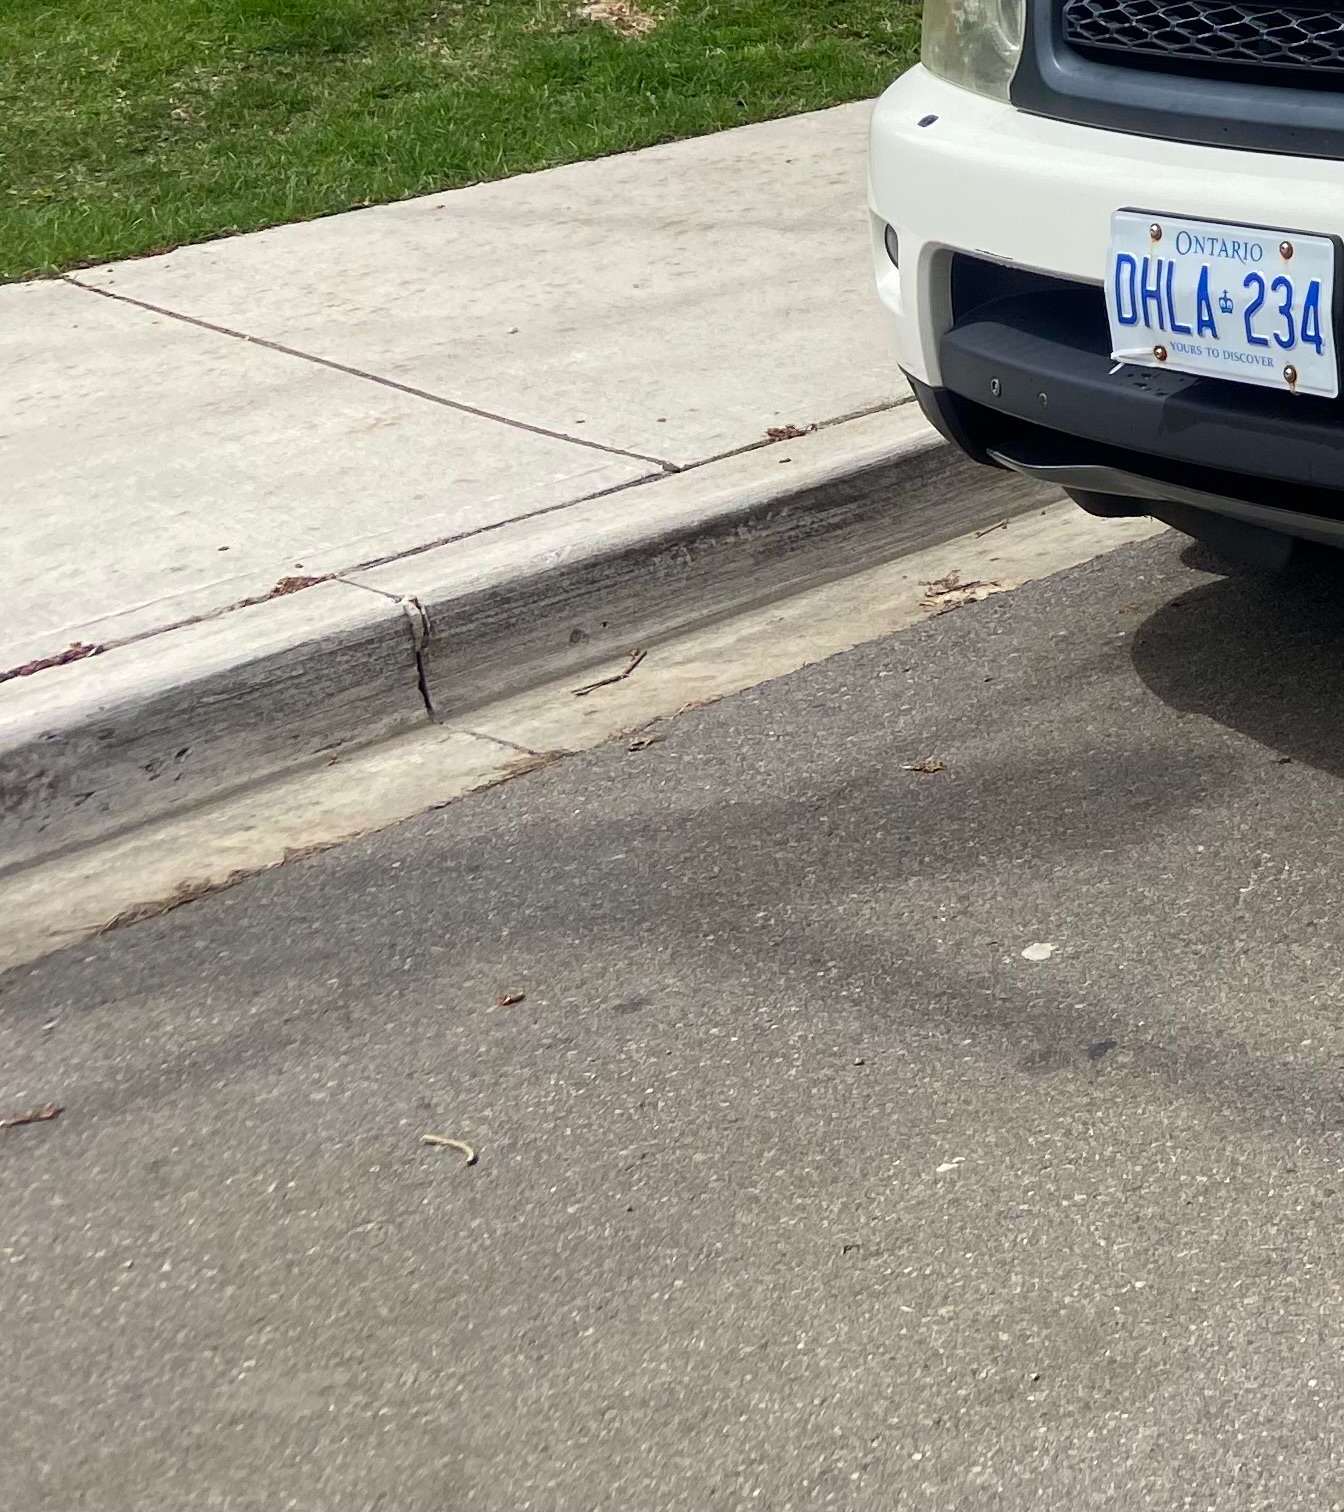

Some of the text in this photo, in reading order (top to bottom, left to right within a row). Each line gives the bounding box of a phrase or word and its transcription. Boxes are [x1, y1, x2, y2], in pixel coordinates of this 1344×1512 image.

[1175, 230, 1264, 264] ONTARIO
[1169, 340, 1275, 368] YOURS TO DISCOVER
